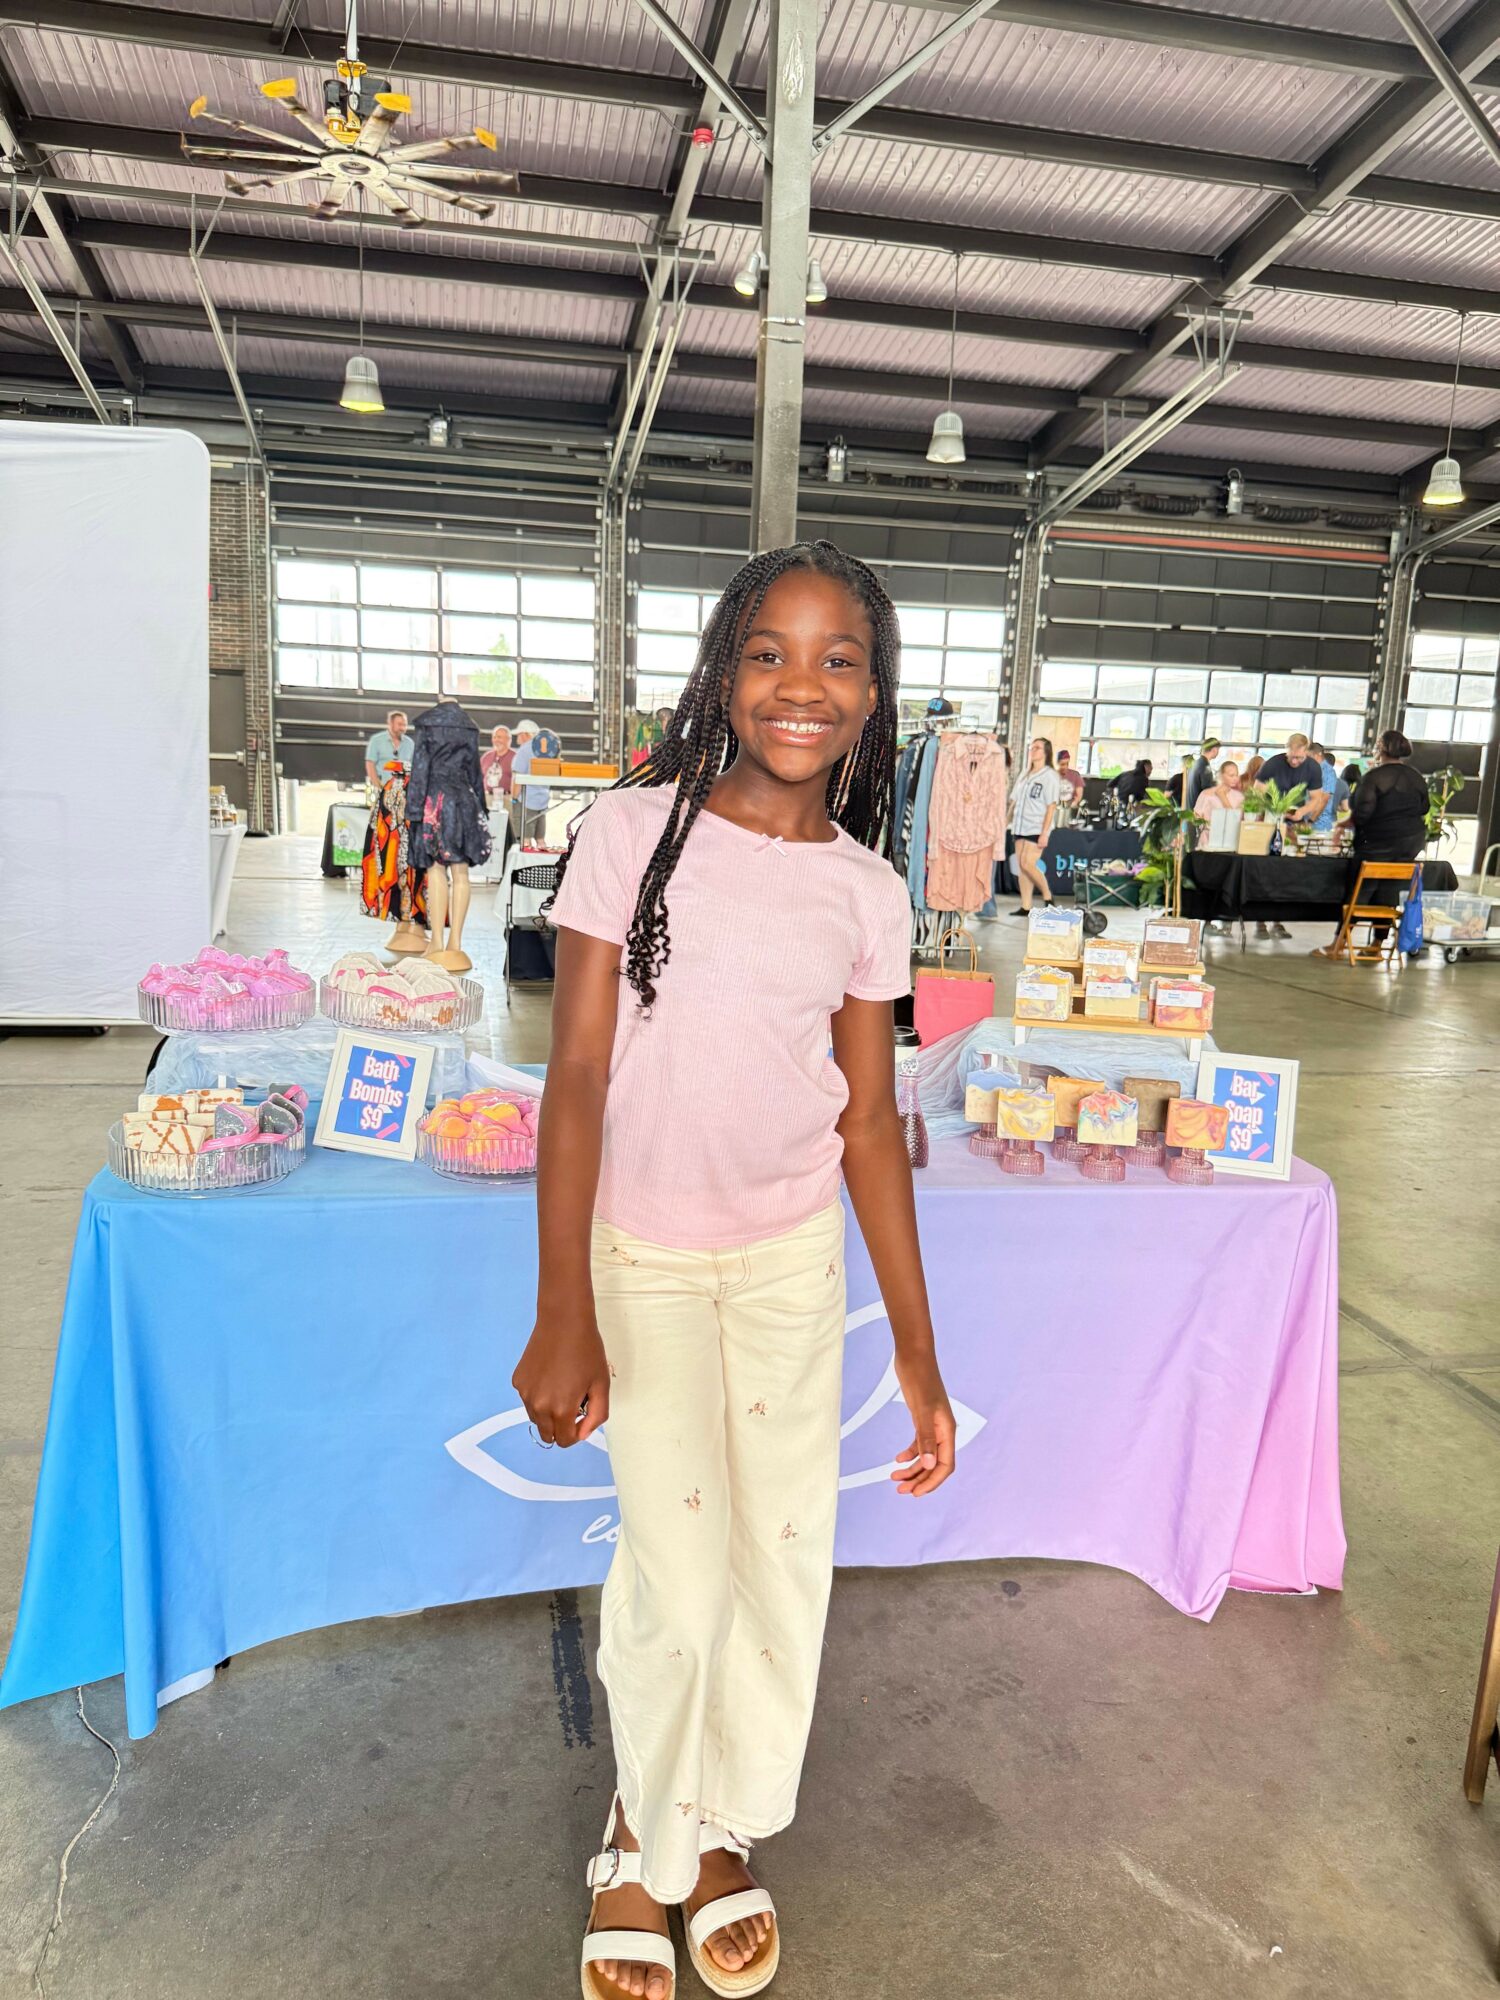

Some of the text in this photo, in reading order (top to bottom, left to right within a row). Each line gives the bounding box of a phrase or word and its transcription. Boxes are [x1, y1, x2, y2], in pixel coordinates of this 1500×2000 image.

[362, 1055, 400, 1082] Bath
[348, 1078, 404, 1108] Bombs
[1231, 1075, 1261, 1100] Bar
[360, 1104, 384, 1130] $9
[1224, 1099, 1264, 1129] Soap
[1229, 1125, 1253, 1152] $9
